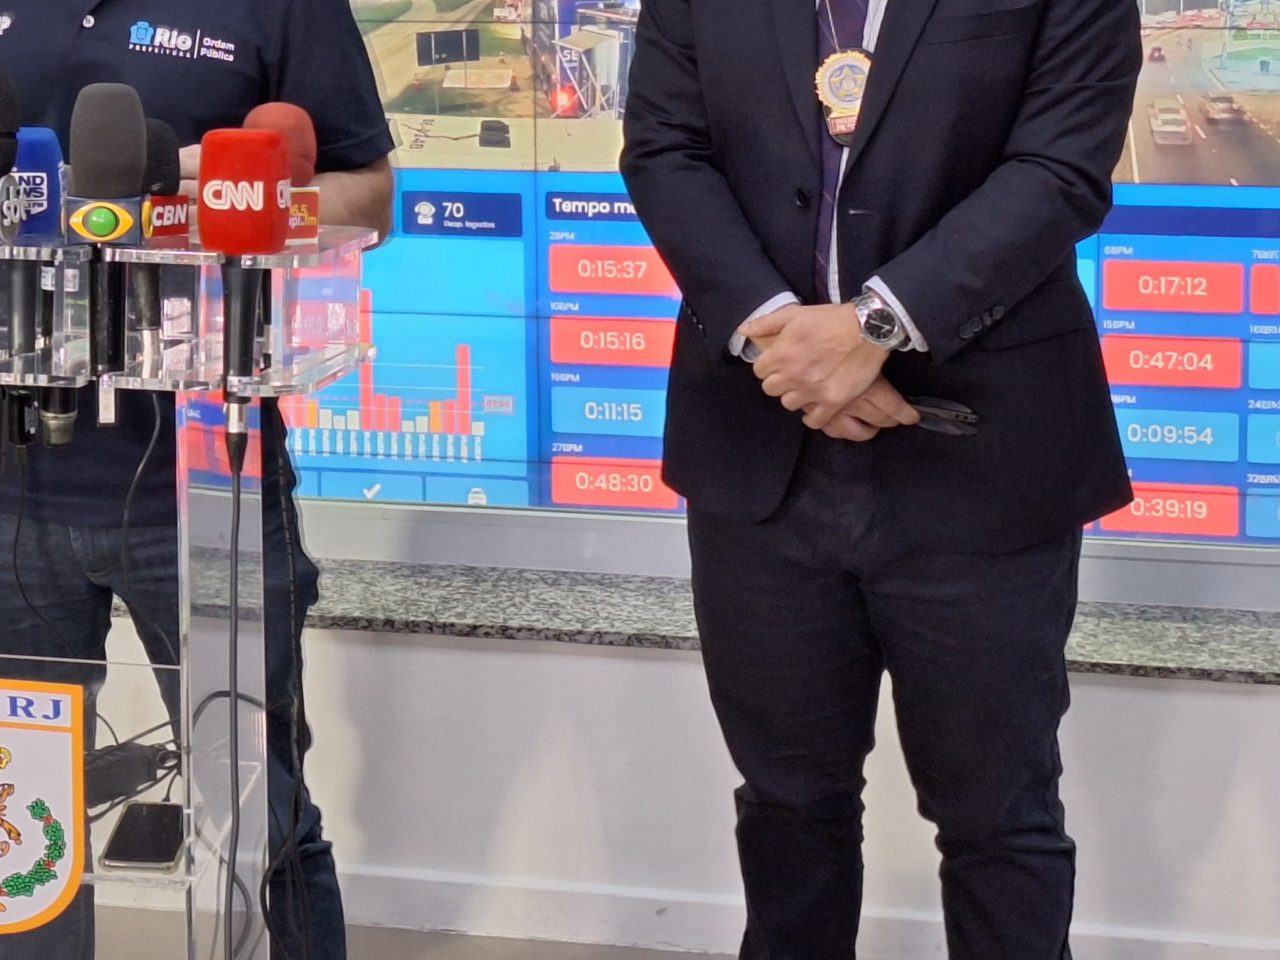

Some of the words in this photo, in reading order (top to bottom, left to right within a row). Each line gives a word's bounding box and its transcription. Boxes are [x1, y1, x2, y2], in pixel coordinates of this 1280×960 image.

[202, 179, 264, 211] CNN
[152, 203, 188, 227] CBN
[441, 202, 464, 218] 70
[552, 198, 611, 218] Tempo
[577, 259, 647, 279] 0:15:37
[1138, 275, 1208, 296] 0:17:12
[580, 330, 646, 350] 0:15:16
[1129, 349, 1214, 371] 0:47:04
[584, 401, 643, 421] 0:11:15
[1127, 423, 1214, 445] 0:09:54
[575, 472, 653, 492] 0:48:30
[1130, 497, 1208, 518] 0:39:19
